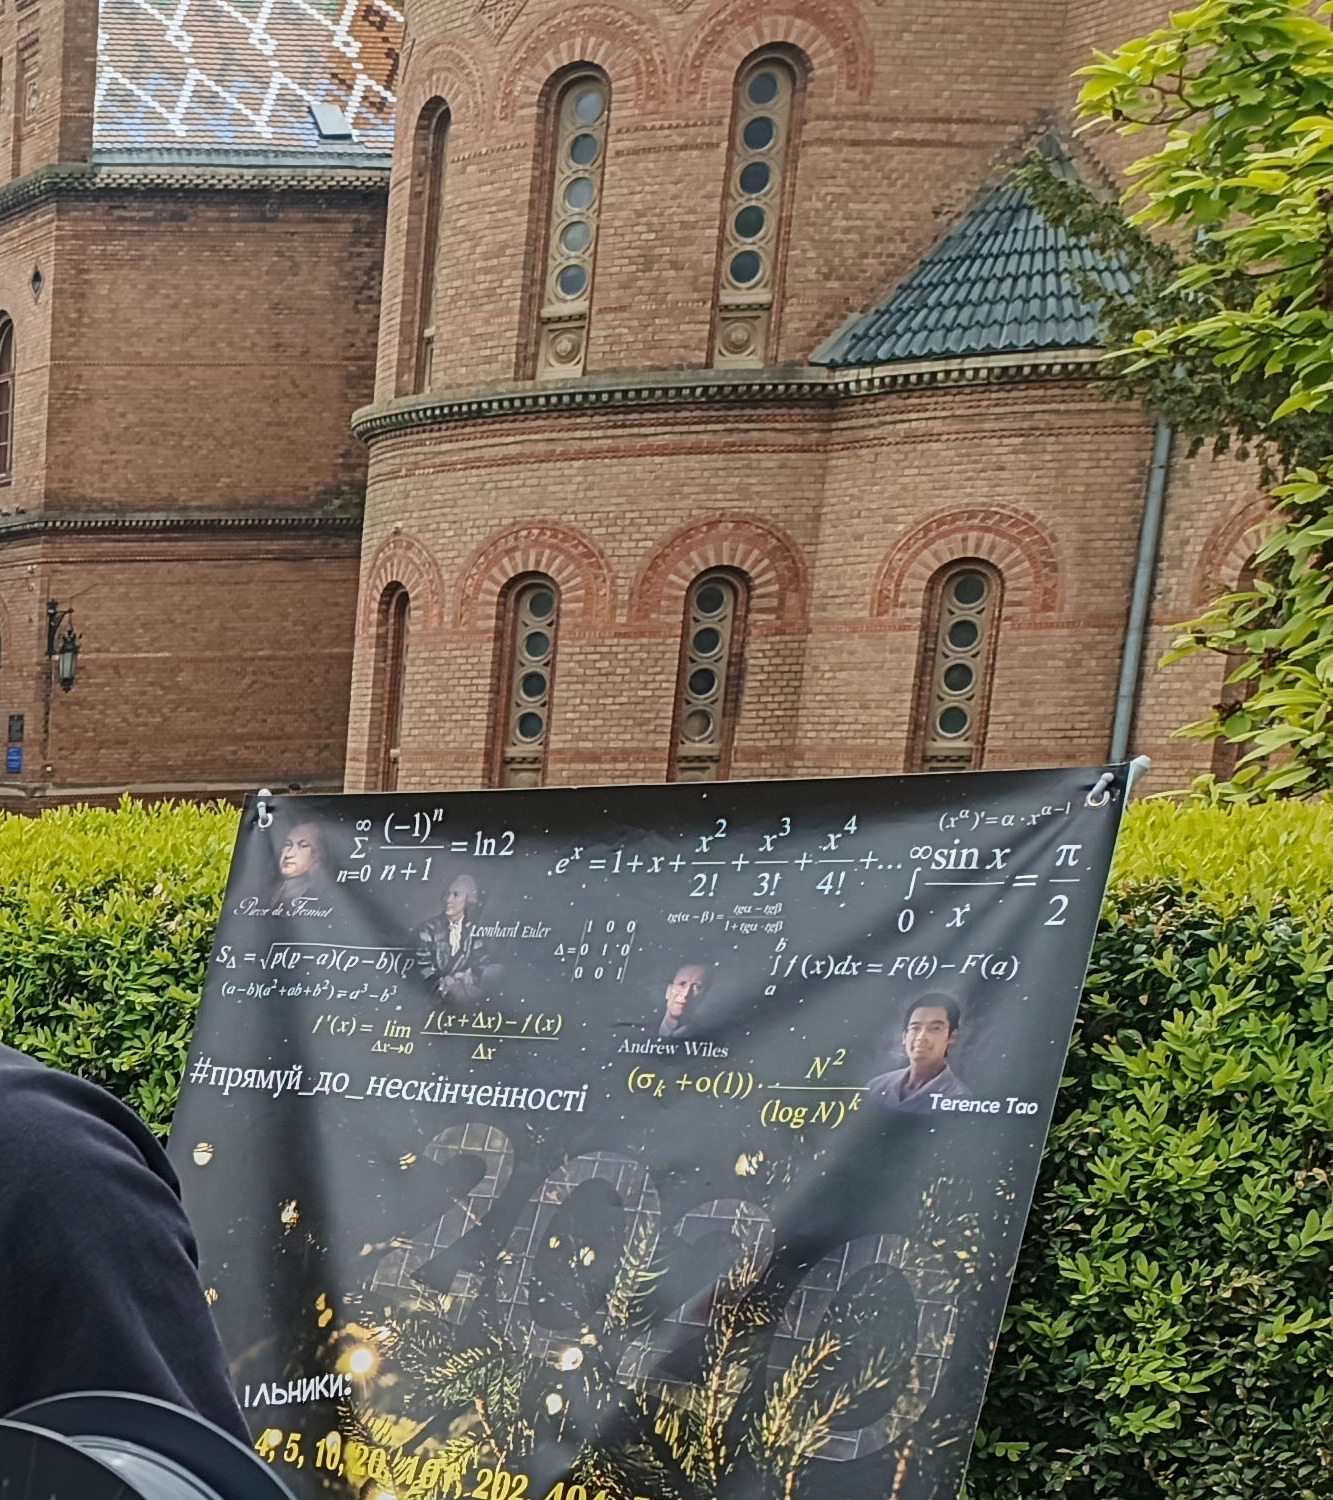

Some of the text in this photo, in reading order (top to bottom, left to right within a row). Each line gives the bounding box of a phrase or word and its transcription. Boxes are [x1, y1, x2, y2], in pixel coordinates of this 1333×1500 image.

[520, 922, 552, 938] Euler
[617, 1038, 729, 1059] Andrew Wiles
[929, 1092, 1039, 1116] Terence Tao
[244, 1372, 353, 1408] ІЛЬНИКИ:
